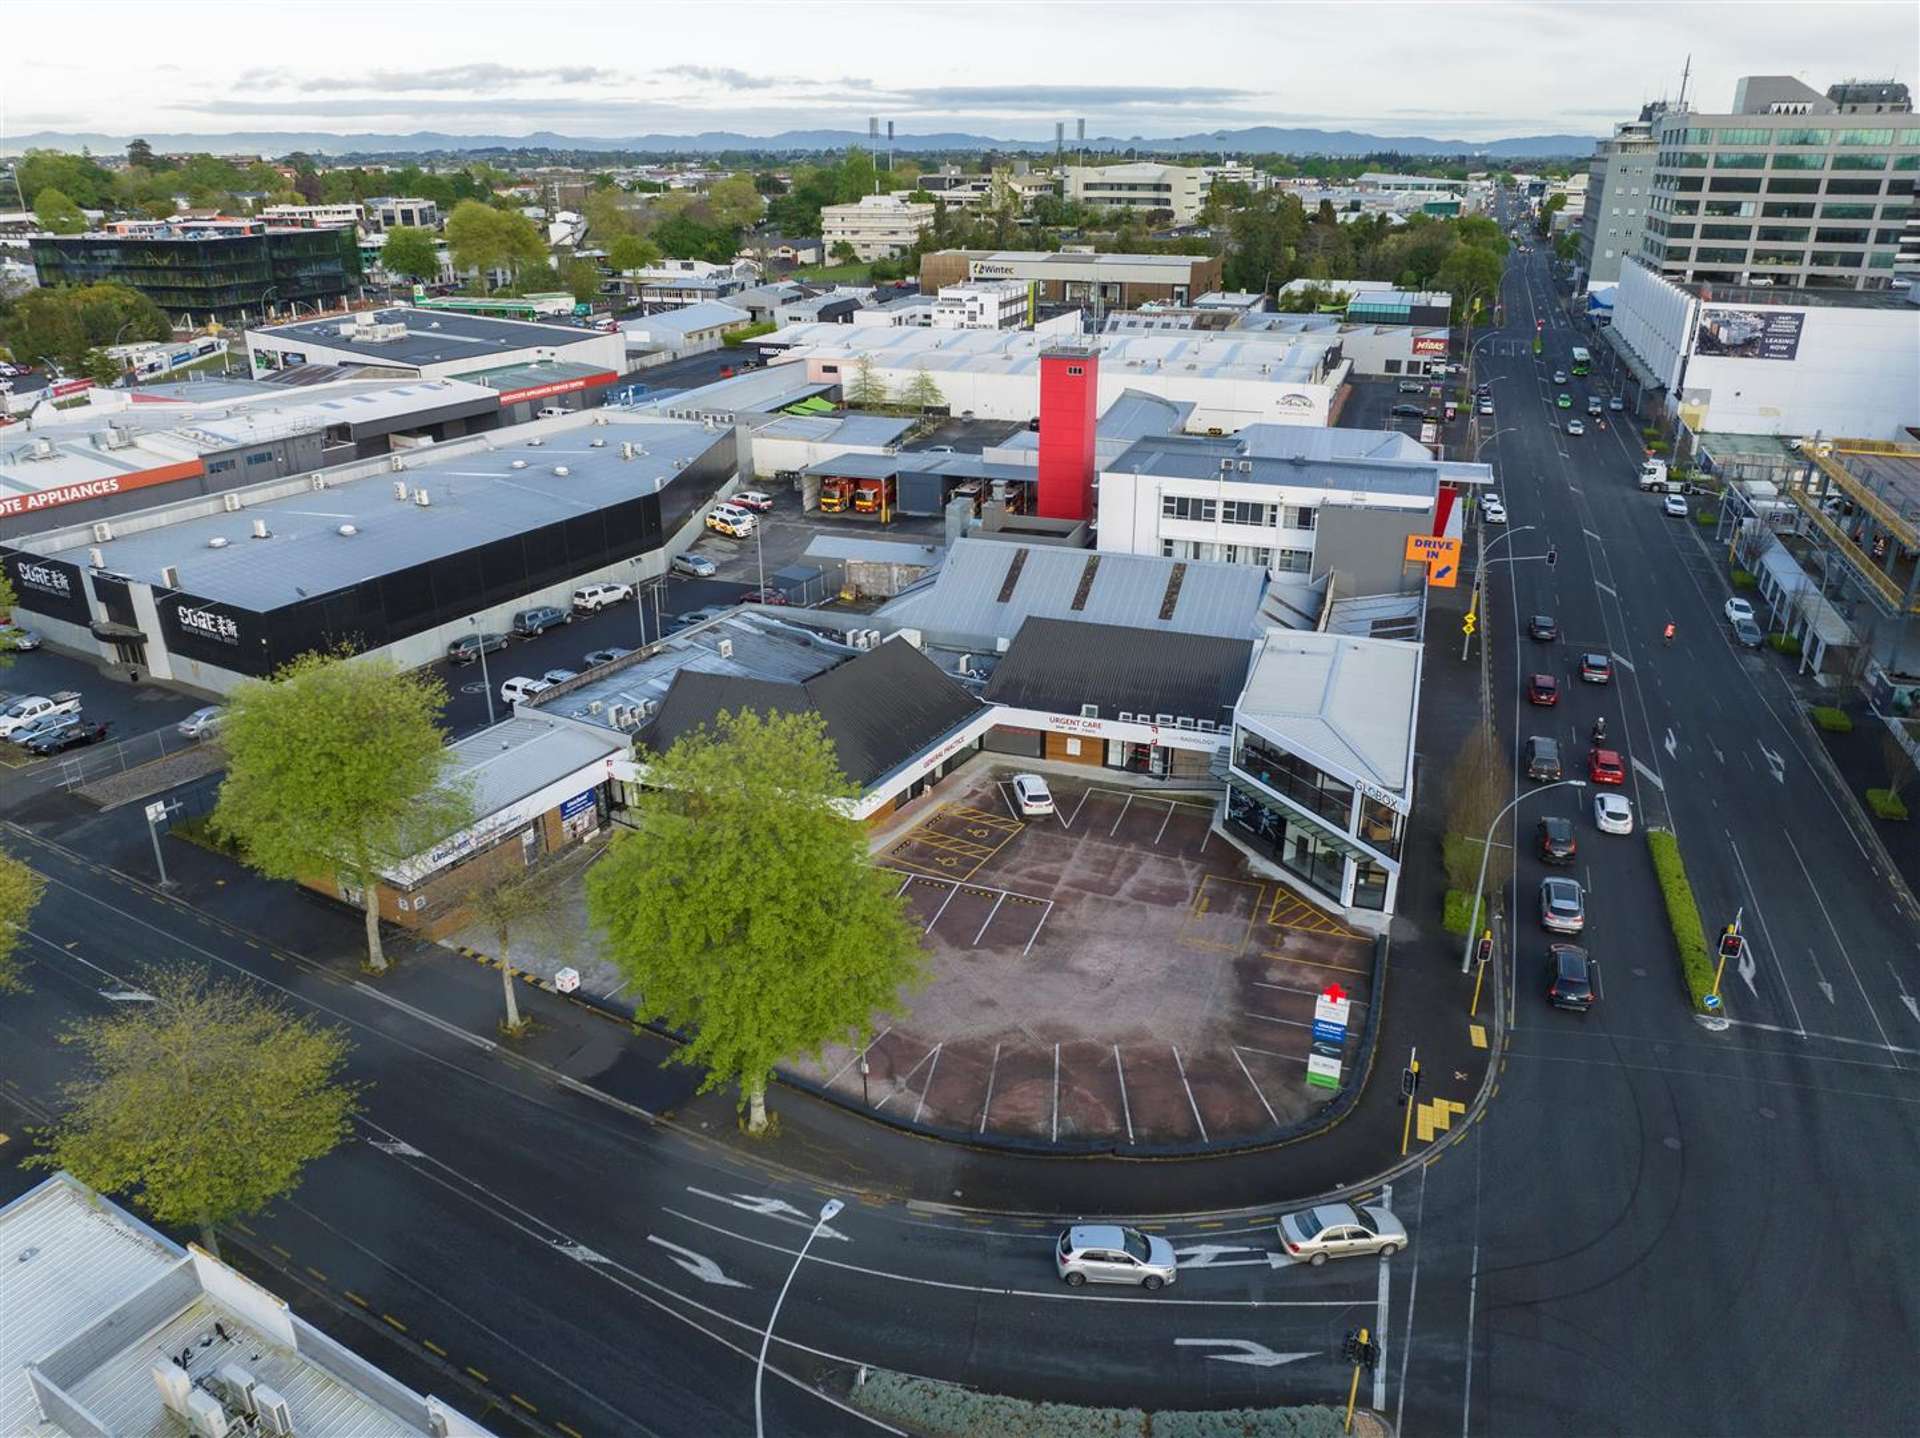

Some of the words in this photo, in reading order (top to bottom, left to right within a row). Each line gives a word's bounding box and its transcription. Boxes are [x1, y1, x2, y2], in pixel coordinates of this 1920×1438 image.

[985, 265, 1014, 274] Wintec
[27, 479, 119, 509] APPLIANCES
[1415, 539, 1454, 550] DRIVE
[1427, 551, 1439, 560] IN
[1049, 717, 1080, 728] URGENT
[1082, 720, 1102, 729] CARE
[1179, 735, 1215, 745] RADIOLOGY
[923, 749, 944, 768] GENERAL
[944, 734, 966, 751] PRACTICE
